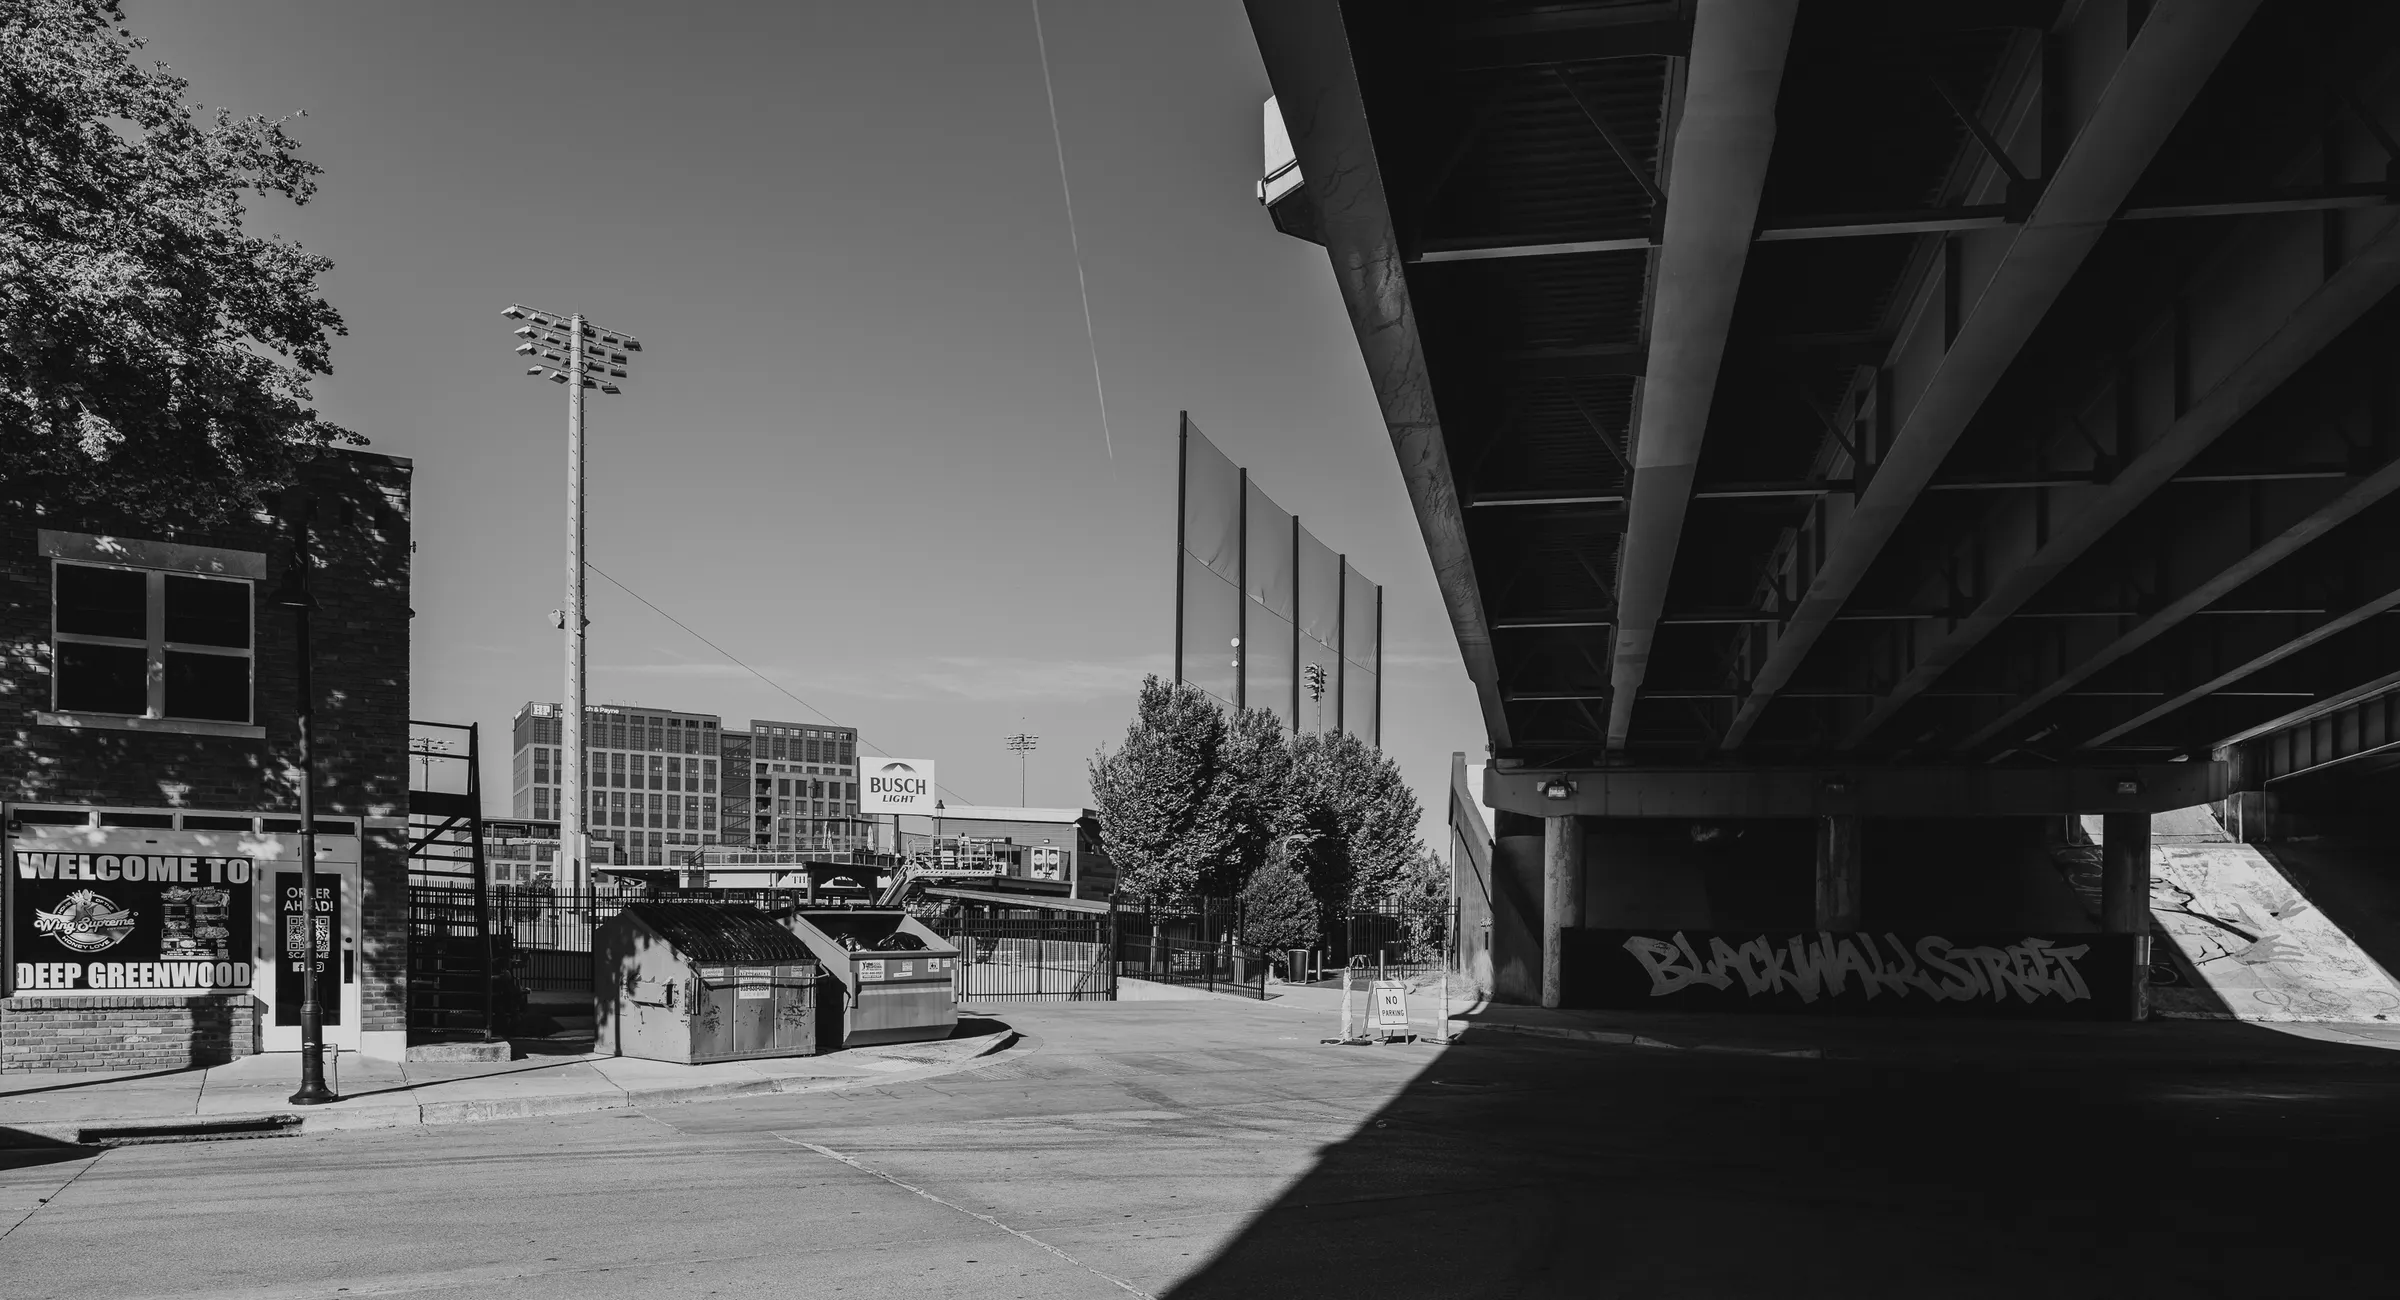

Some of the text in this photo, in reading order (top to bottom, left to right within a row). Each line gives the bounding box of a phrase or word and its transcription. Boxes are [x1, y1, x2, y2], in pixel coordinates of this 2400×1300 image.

[533, 704, 550, 715] HP
[599, 706, 620, 714] Payne
[870, 777, 926, 795] BUSCH
[882, 795, 915, 804] LIGHT
[17, 853, 250, 884] WELCOME TO
[287, 887, 330, 899] ORER
[58, 901, 72, 915] HOME
[102, 901, 114, 910] THE
[284, 900, 334, 912] AHAD!
[34, 917, 135, 935] Wing Supreme
[61, 936, 111, 949] HONEY LOVE
[16, 962, 250, 989] DEEP GREENWOOD
[1385, 996, 1398, 1005] NO
[1382, 1009, 1405, 1017] PARKING
